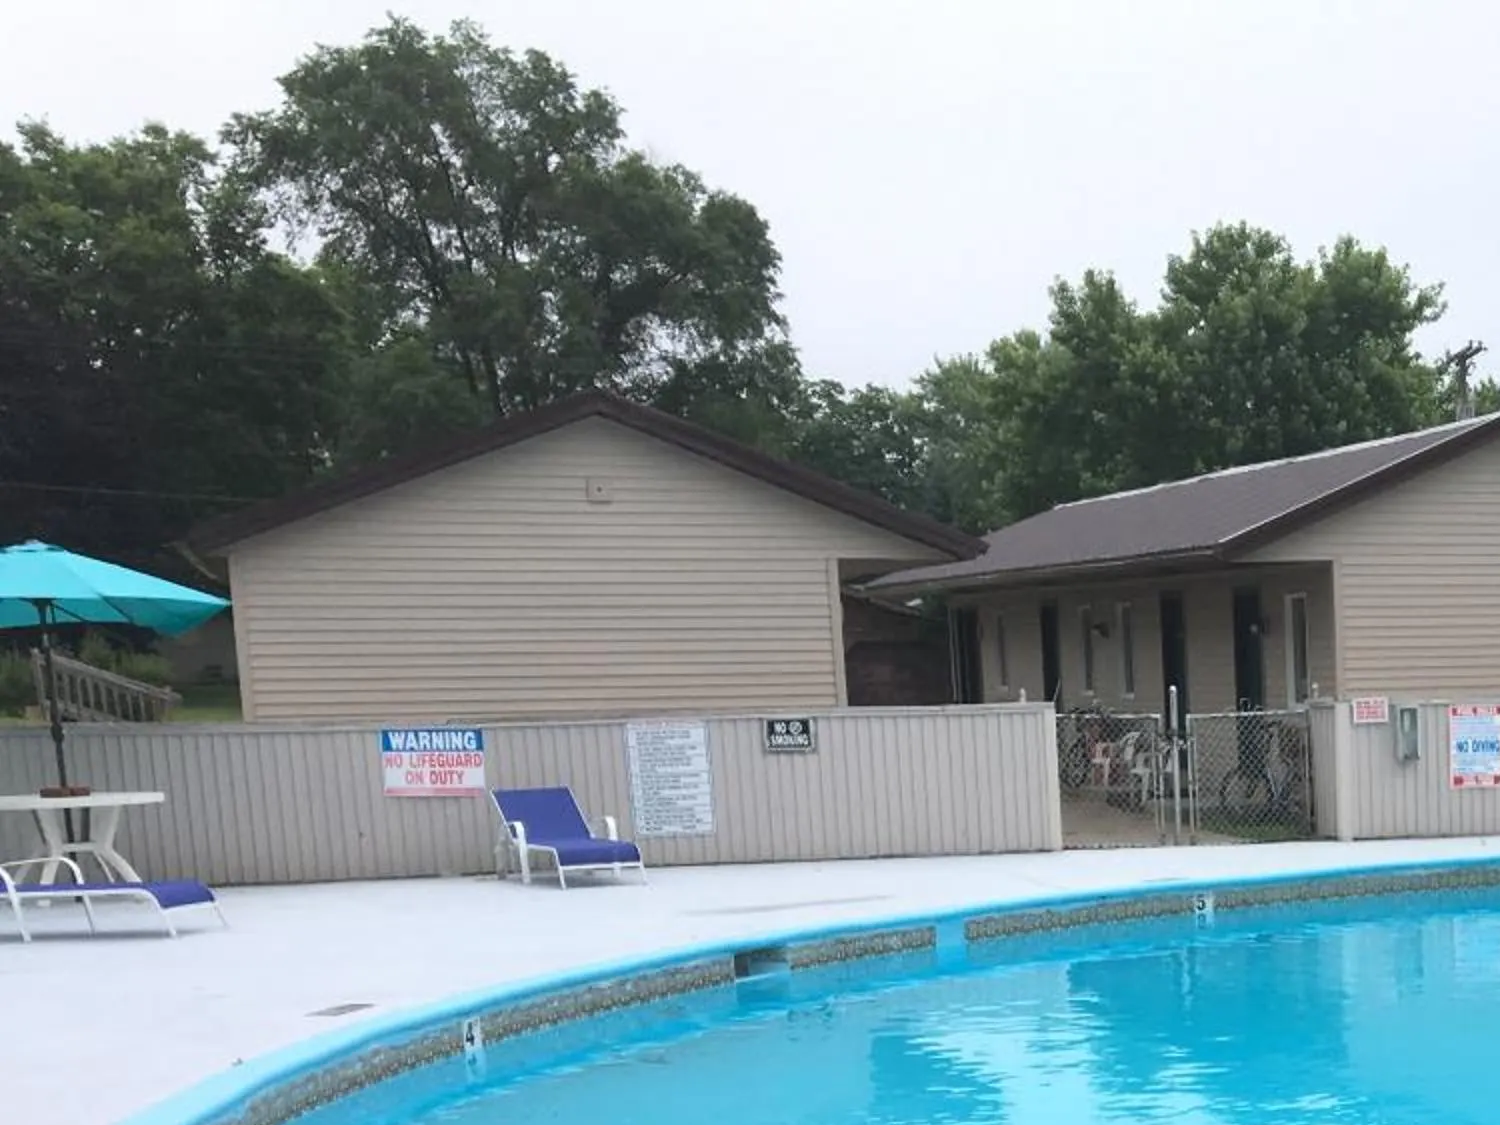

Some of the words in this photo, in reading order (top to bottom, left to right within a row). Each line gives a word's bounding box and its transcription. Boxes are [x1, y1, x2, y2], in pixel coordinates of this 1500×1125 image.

[774, 722, 787, 734] NO
[388, 731, 476, 750] WARNING
[1456, 739, 1469, 753] NO
[1471, 739, 1500, 753] DIVING
[384, 753, 403, 769] NO
[409, 752, 483, 769] LIFEGUARD
[405, 769, 425, 785] ON
[429, 769, 464, 785] DUTY
[1196, 893, 1206, 911] 5
[466, 1021, 475, 1047] 4
